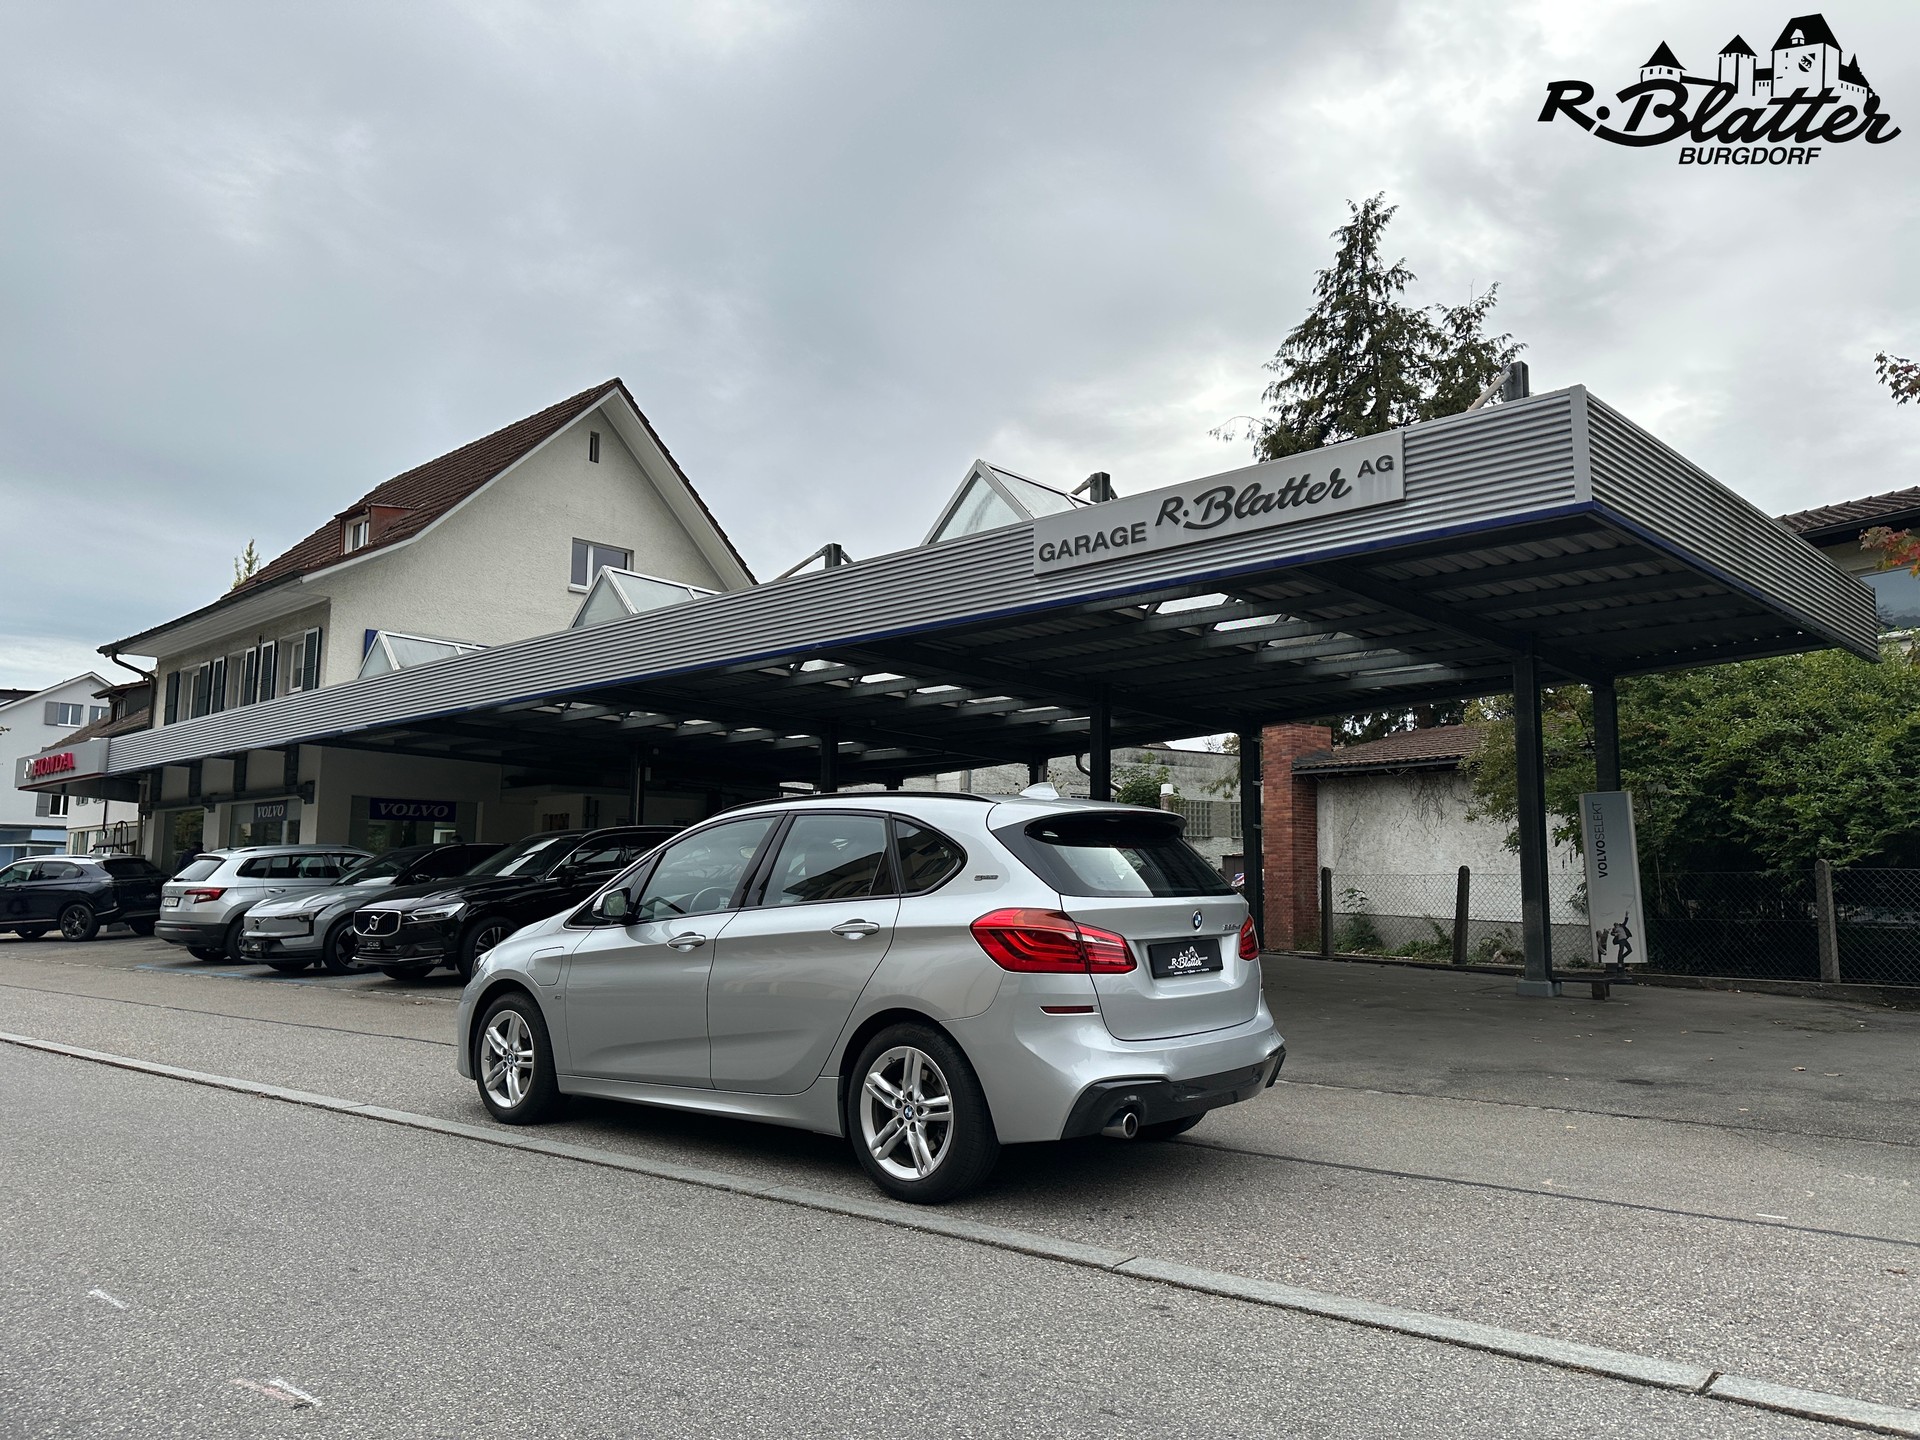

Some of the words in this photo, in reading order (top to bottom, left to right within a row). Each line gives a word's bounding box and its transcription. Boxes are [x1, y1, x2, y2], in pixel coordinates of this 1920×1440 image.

[1038, 521, 1147, 562] GARAGE
[1358, 454, 1394, 478] AG
[33, 752, 75, 777] HONDA
[257, 804, 284, 818] VOLVO
[378, 802, 448, 818] VOLVO
